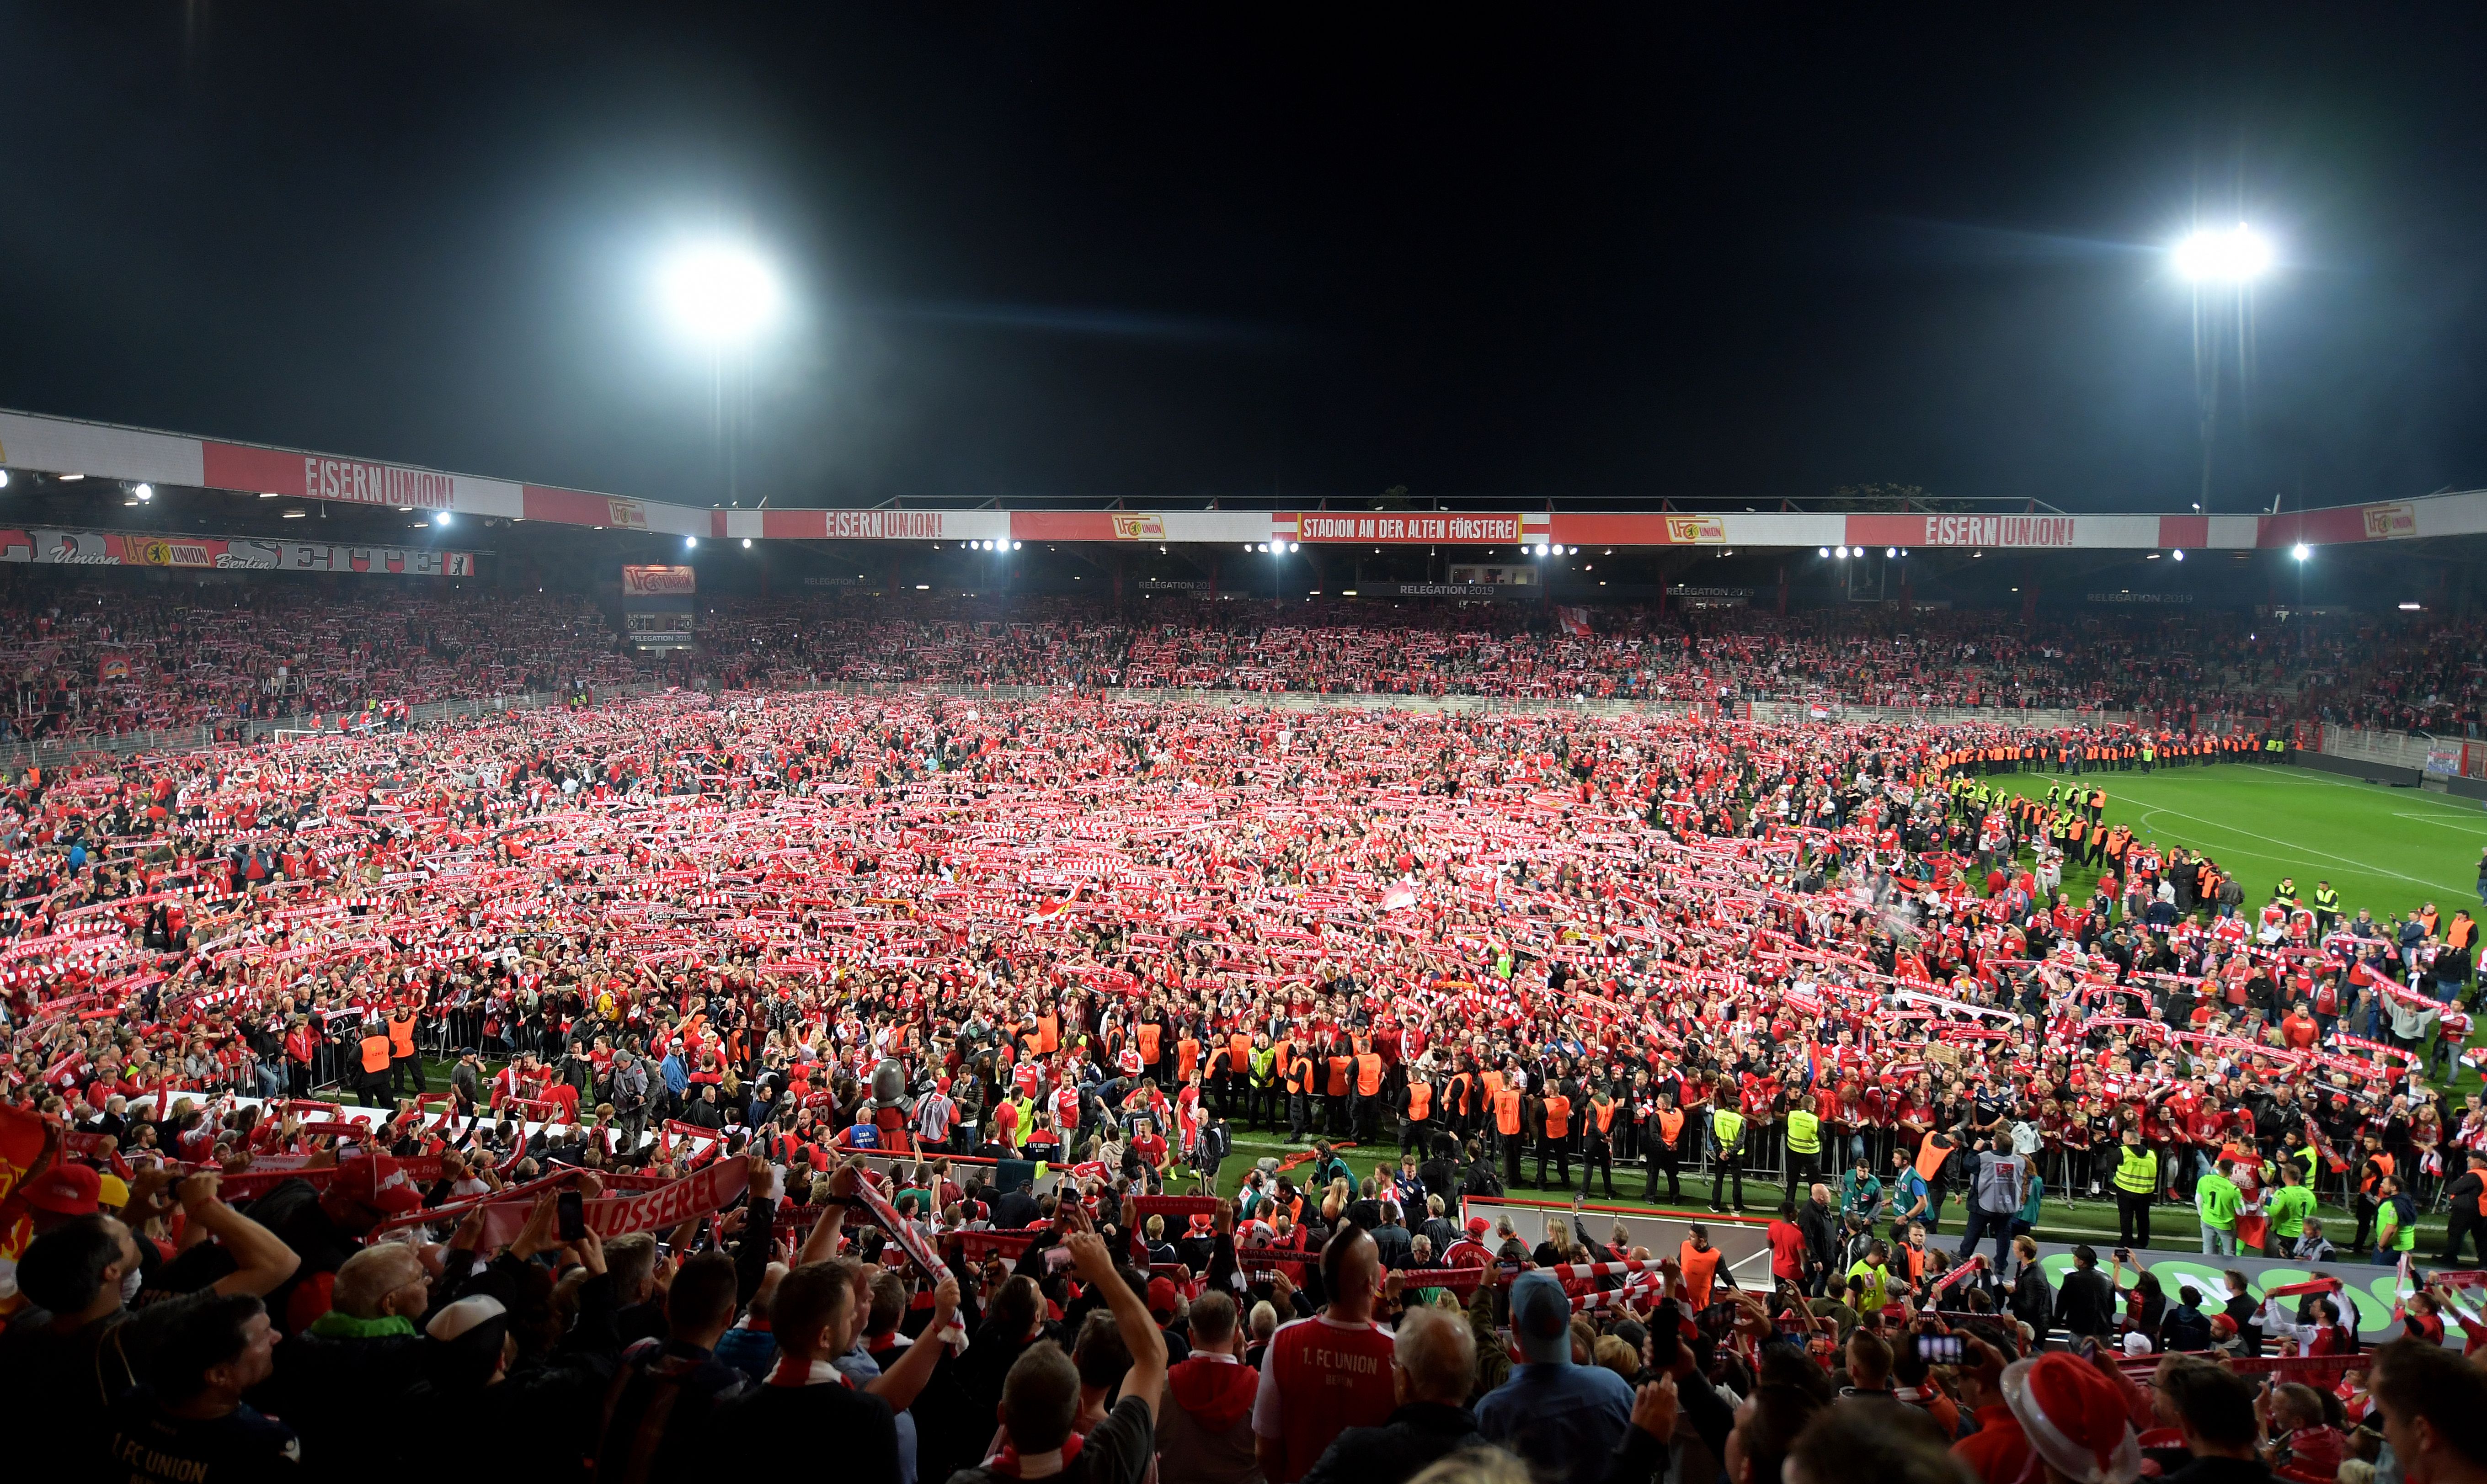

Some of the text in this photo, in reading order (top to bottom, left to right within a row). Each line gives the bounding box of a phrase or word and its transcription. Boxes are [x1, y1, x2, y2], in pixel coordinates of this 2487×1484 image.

[305, 458, 454, 509] EISERN UNION!
[826, 512, 942, 537] EISERN UNION!
[1142, 524, 1162, 534] UNION
[1303, 517, 1517, 538] STADION AN DER ALTEN FÖRSTEREI
[1699, 527, 1721, 537] UNION
[1926, 517, 2074, 546] EISERN UNION!
[49, 546, 121, 565] Union
[172, 545, 210, 565] UNION
[215, 553, 273, 569] Berlin
[1400, 585, 1494, 595] RELEGATION 2019
[2087, 594, 2193, 603] RELEGATION 2019
[654, 929, 688, 938] WALDSEITE
[283, 950, 300, 958] UNION
[881, 941, 919, 950] UNIONER
[1907, 978, 1950, 994] UNIONER
[2155, 973, 2177, 981] Union
[2178, 975, 2202, 984] Berlin
[1828, 986, 1873, 999] UNIONER
[2396, 987, 2418, 1000] Union
[2419, 996, 2443, 1006] Berlin
[2338, 1035, 2408, 1057] UNIONER
[811, 1105, 828, 1122] 28
[2209, 1191, 2216, 1210] 1
[2300, 1201, 2306, 1218] 1
[1866, 1289, 1876, 1298] 29
[1302, 1346, 1378, 1375] 1. FC UNION
[123, 1439, 144, 1463] FC
[146, 1451, 208, 1484] UNION
